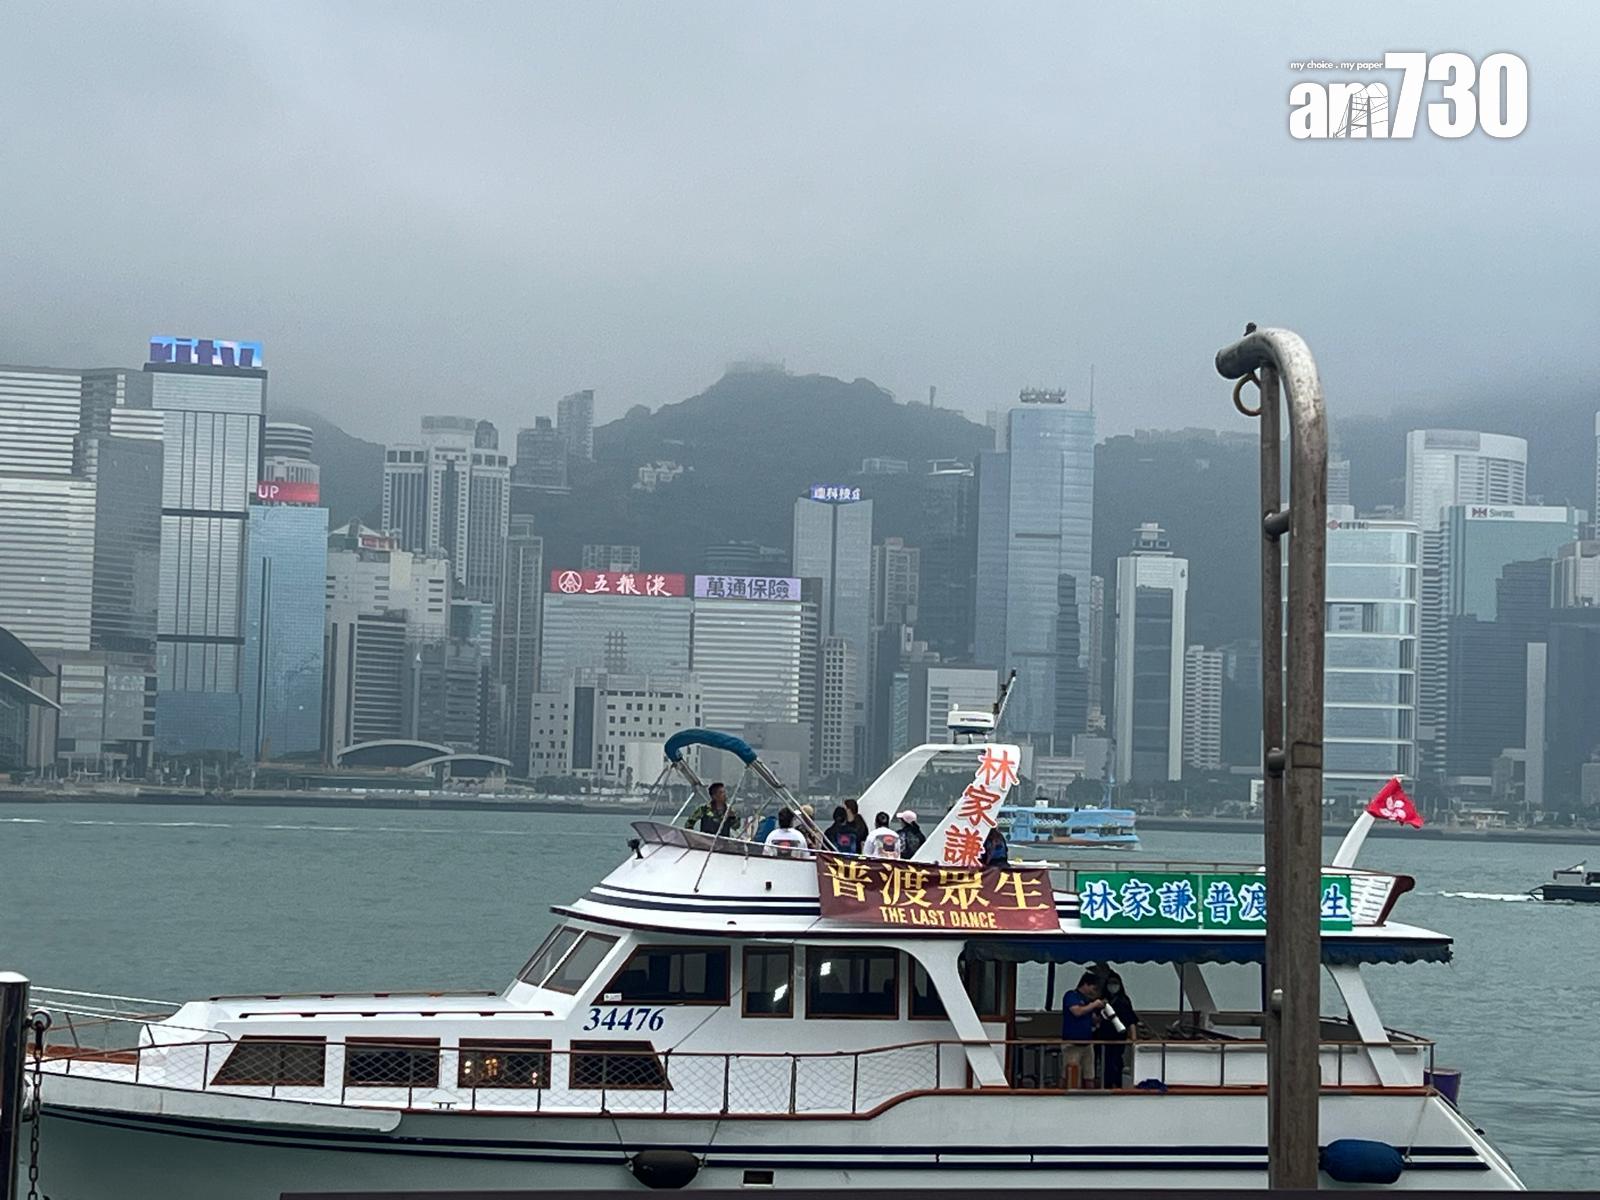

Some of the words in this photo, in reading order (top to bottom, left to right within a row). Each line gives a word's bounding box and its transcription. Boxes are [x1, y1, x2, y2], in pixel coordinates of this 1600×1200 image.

[258, 485, 279, 499] UP
[706, 576, 790, 599] 萬通保險
[944, 747, 1019, 867] 林家謙
[1080, 879, 1196, 922] 林家謙
[1203, 881, 1350, 923] 普渡生
[879, 906, 908, 924] THE
[909, 908, 945, 926] LAST
[949, 910, 998, 929] DANCE
[583, 1007, 666, 1032] 34476
